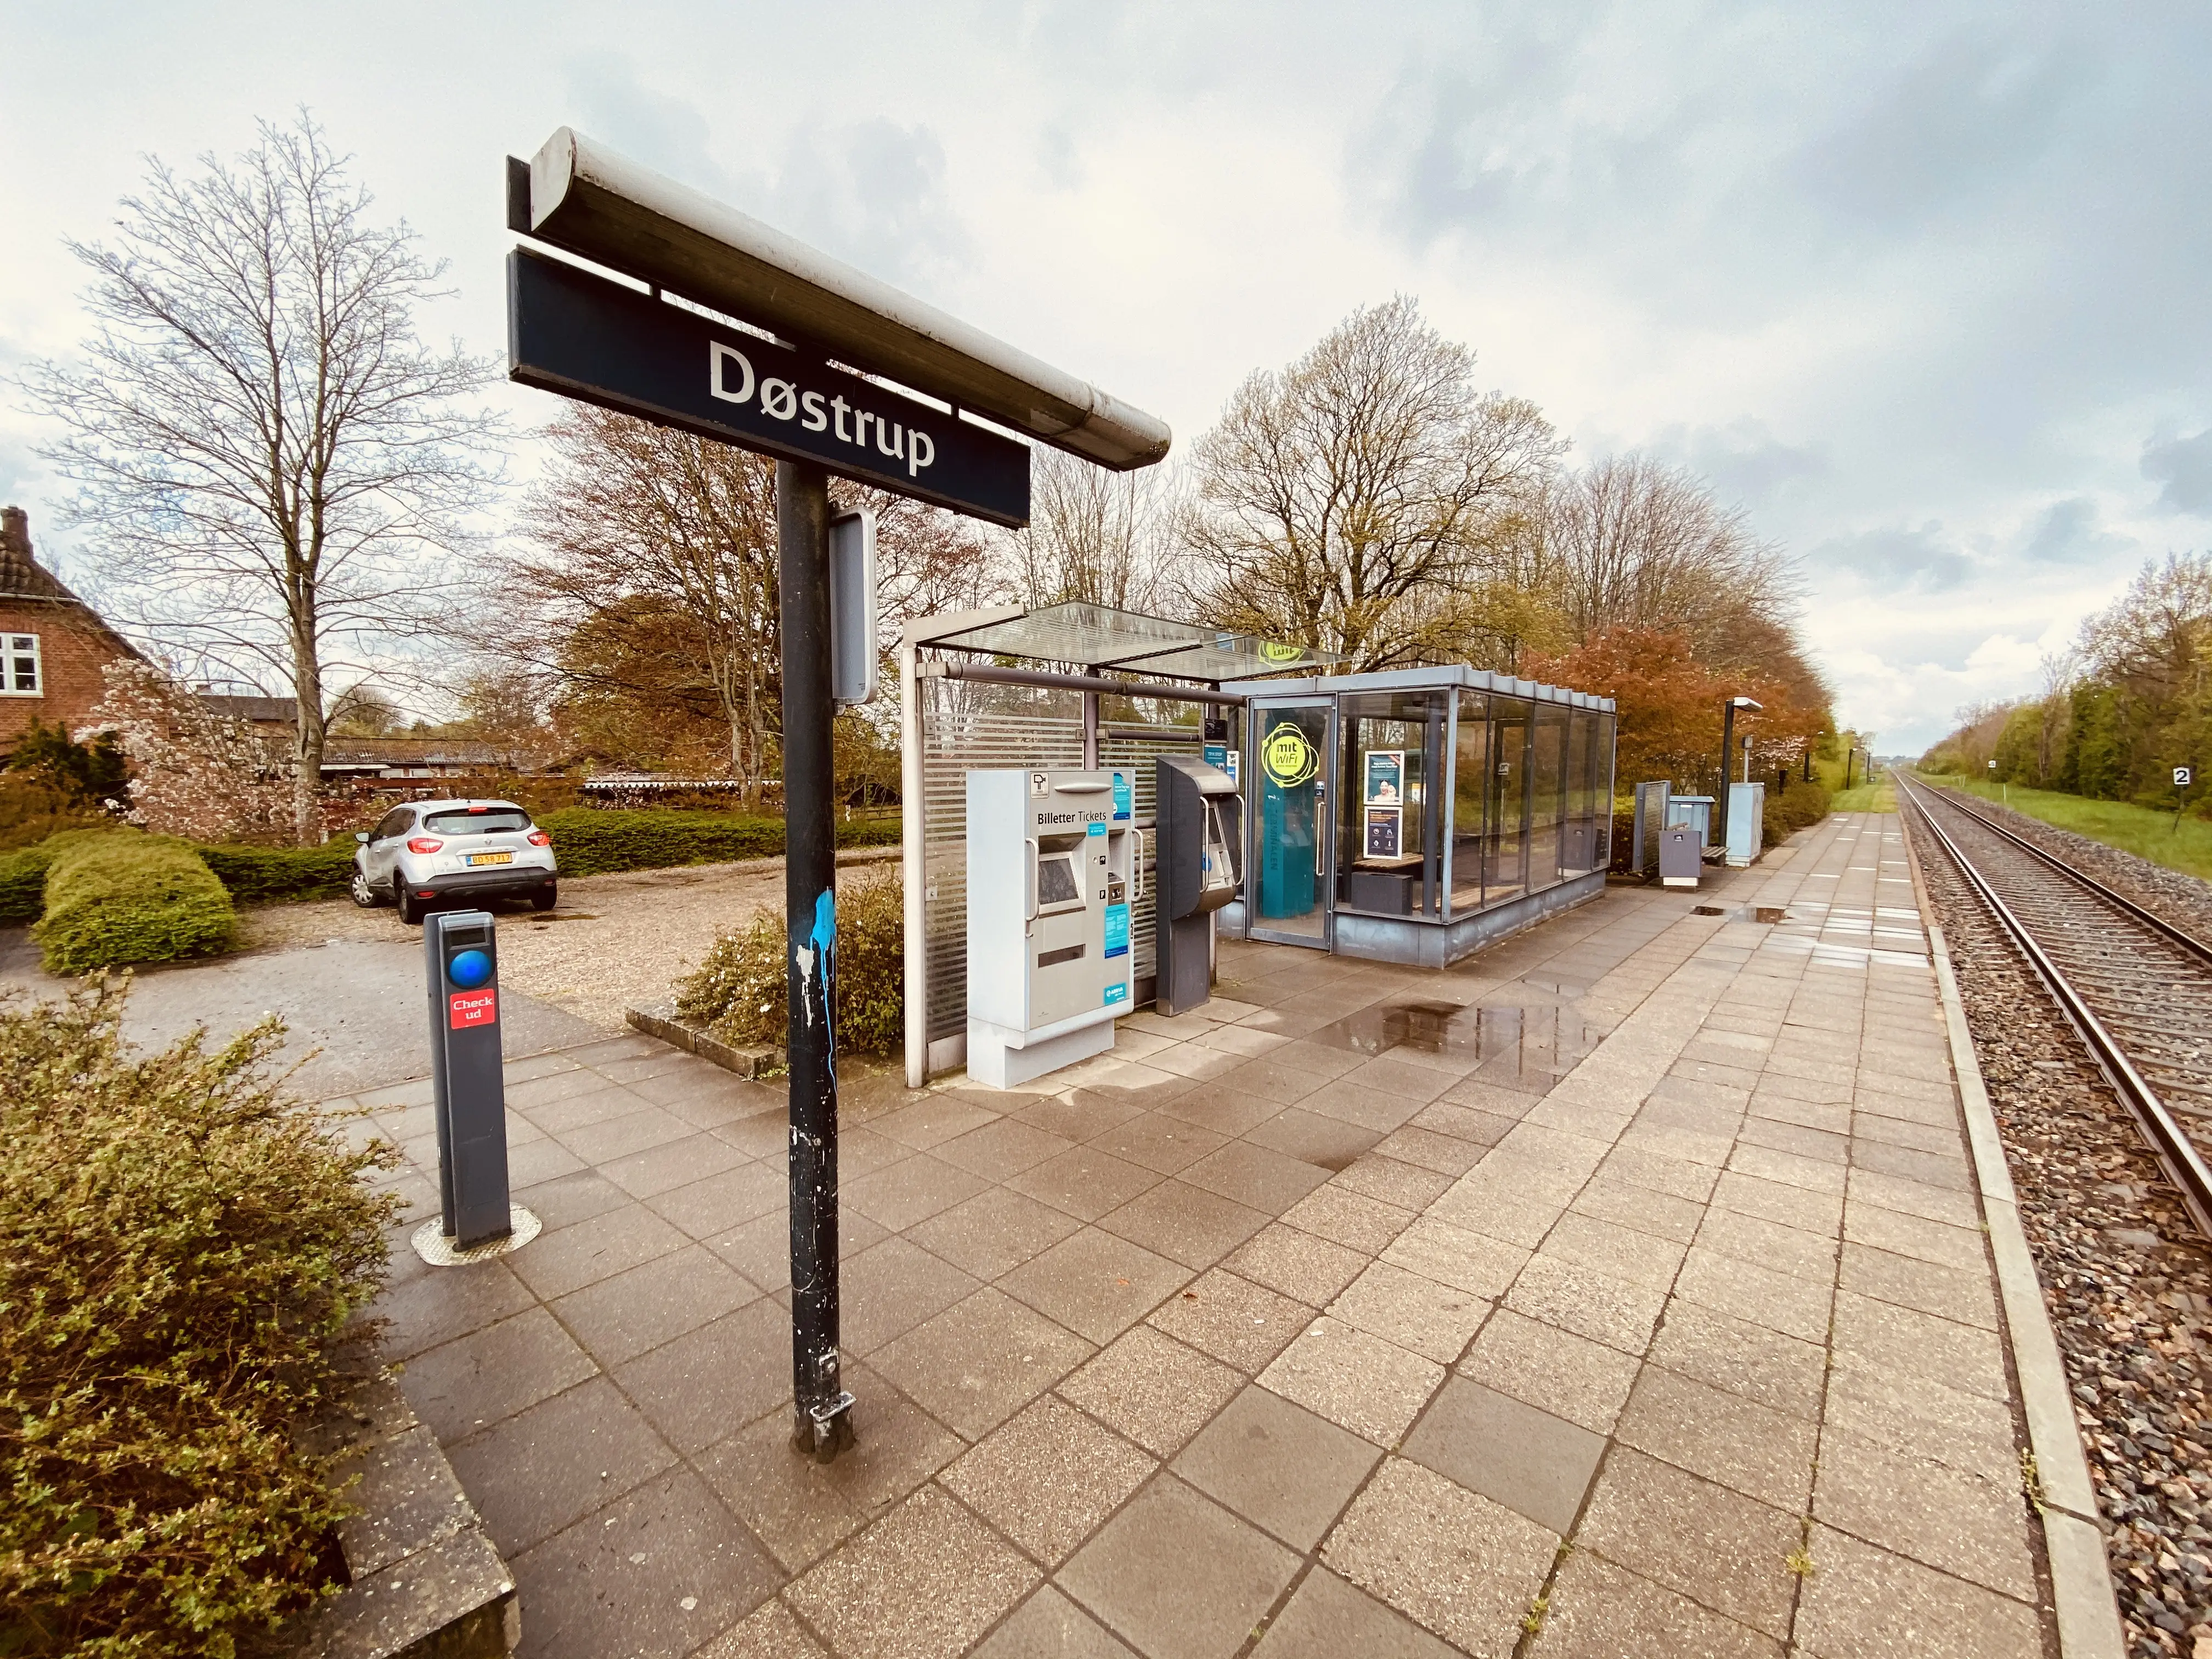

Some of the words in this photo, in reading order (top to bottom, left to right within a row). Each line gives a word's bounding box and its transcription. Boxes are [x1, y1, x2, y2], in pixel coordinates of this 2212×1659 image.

[710, 340, 935, 477] Døstrup
[1277, 742, 1297, 752] mit
[1276, 753, 1297, 764] WiFi
[2175, 770, 2188, 783] 2
[1038, 812, 1076, 825] Billetter
[1077, 810, 1107, 822] Tickets
[453, 996, 493, 1011] Check
[465, 1008, 482, 1020] ud
